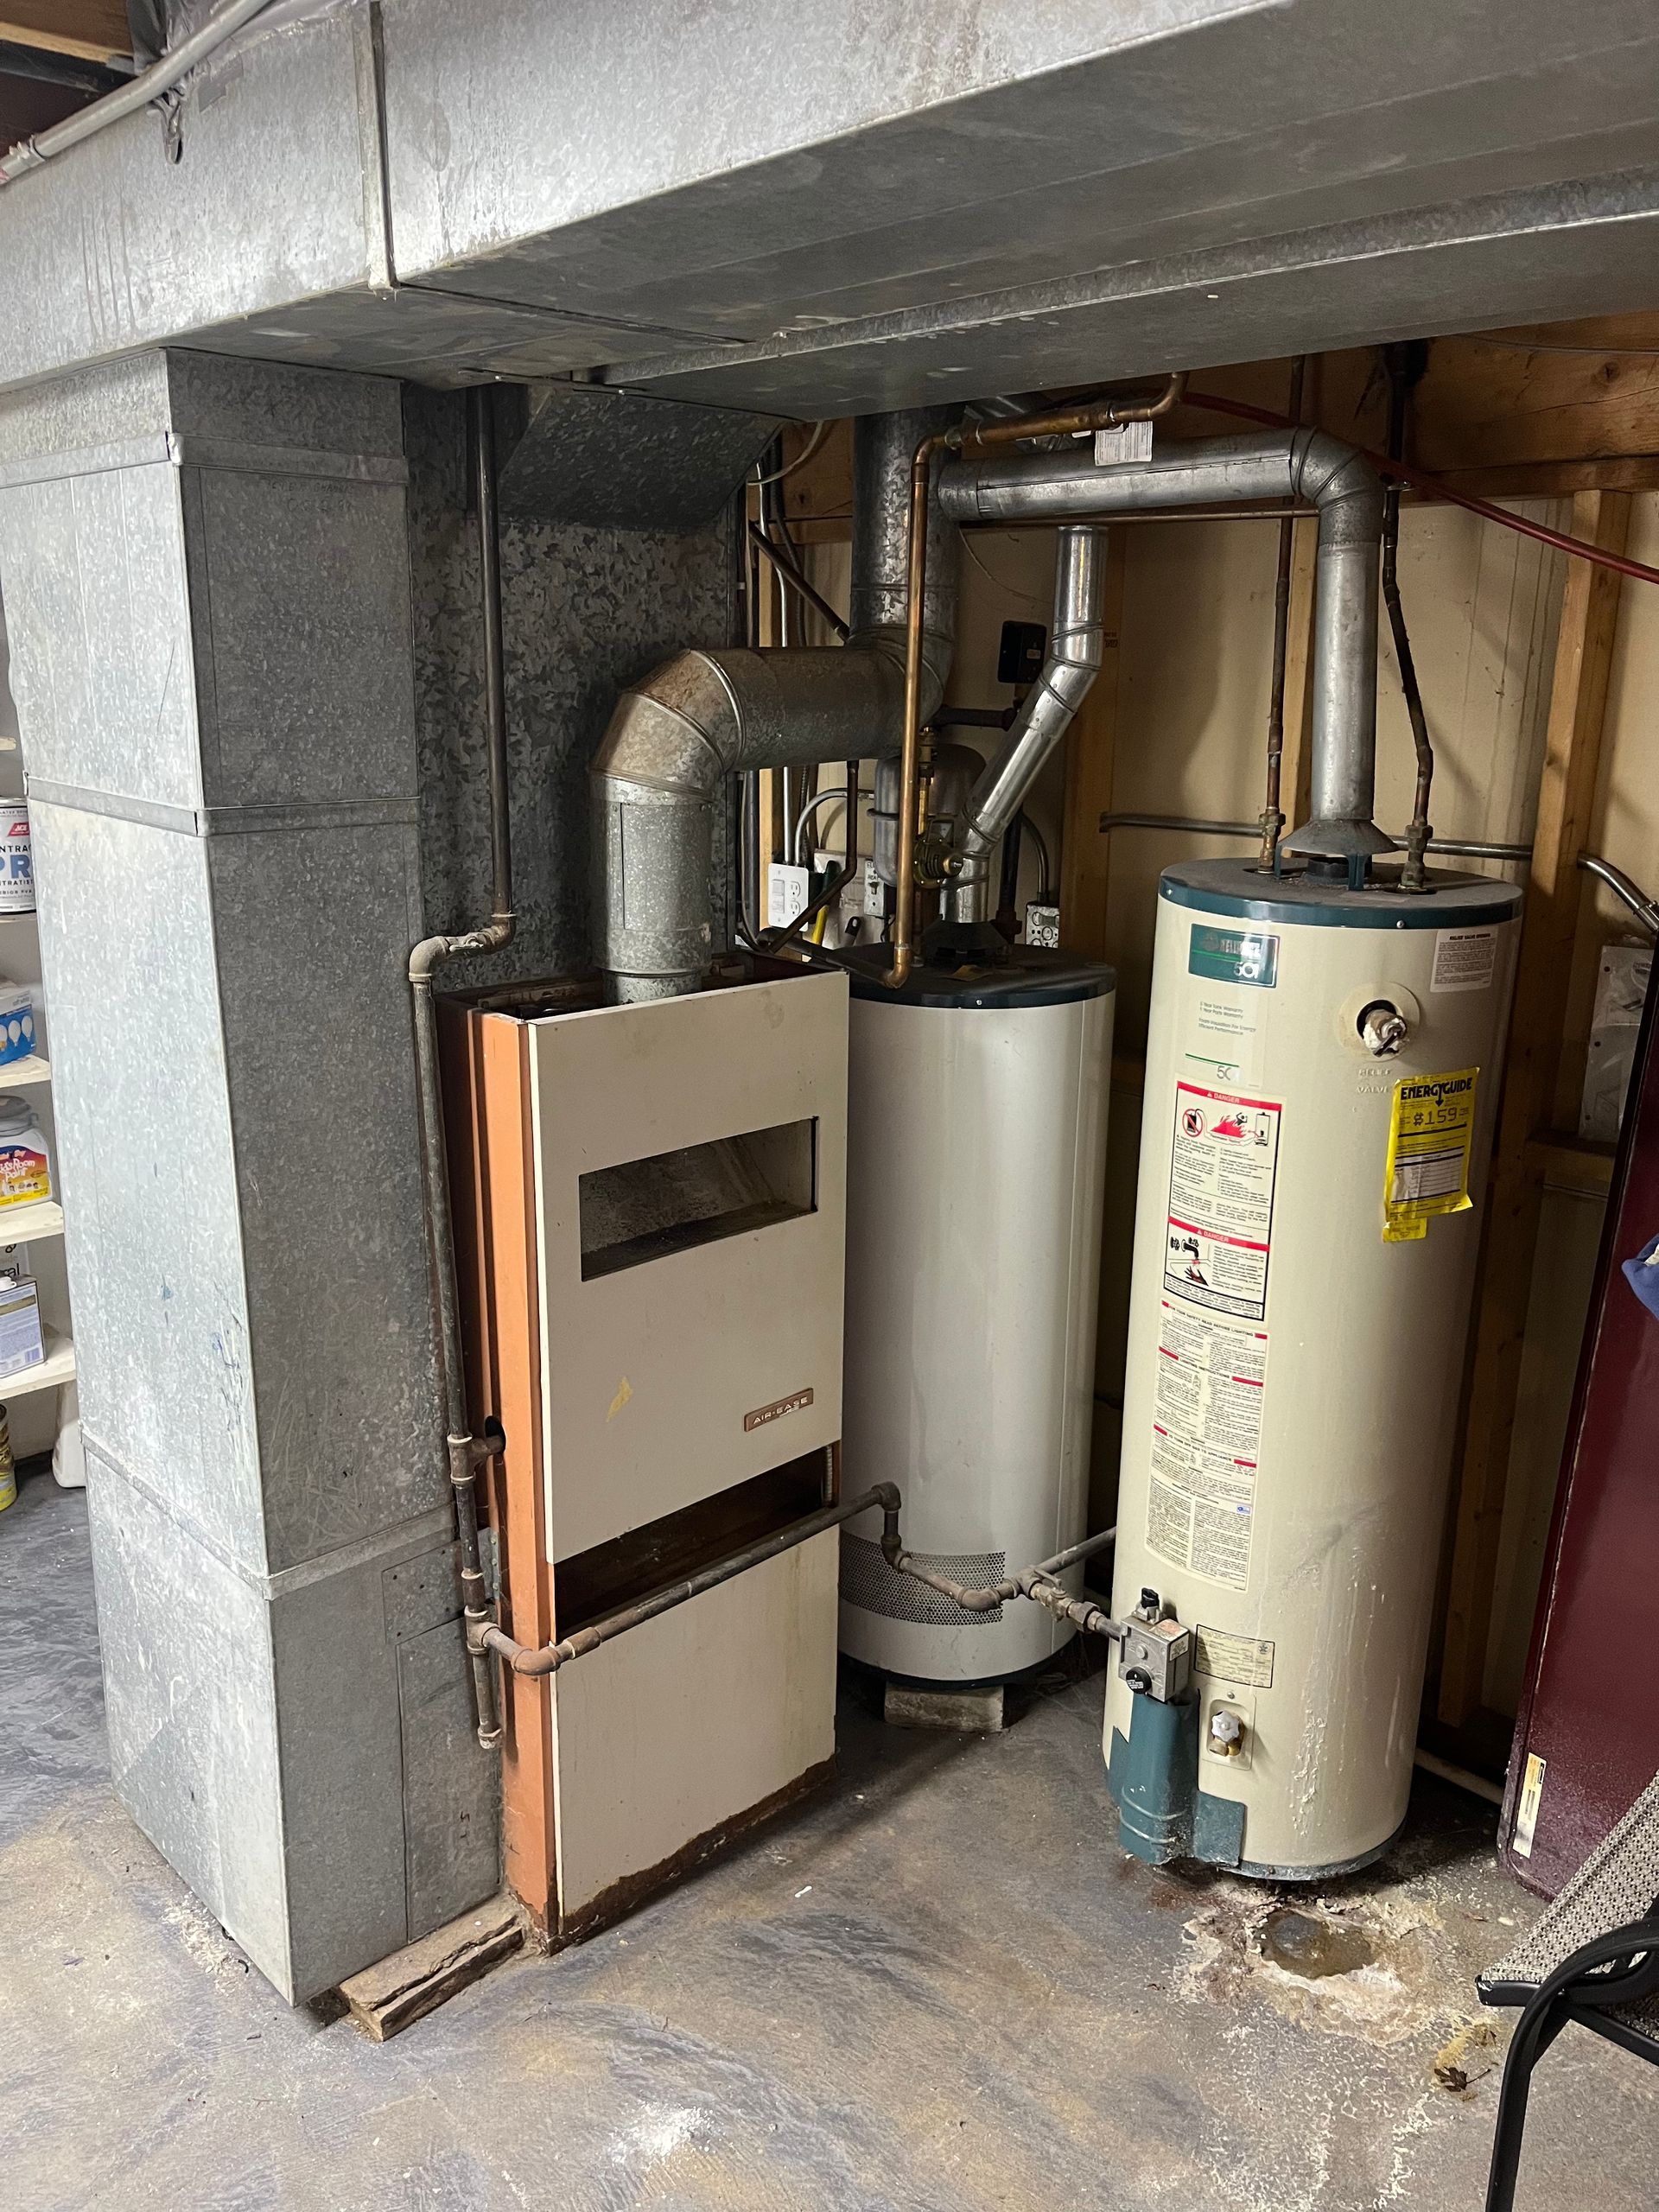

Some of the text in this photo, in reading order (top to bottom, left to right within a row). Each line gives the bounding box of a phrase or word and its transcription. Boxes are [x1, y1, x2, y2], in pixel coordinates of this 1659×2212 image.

[1401, 1077, 1472, 1101] ENERGYGUIDE
[1214, 1092, 1240, 1104] DANGER
[13, 1158, 35, 1170] Room
[1204, 1231, 1230, 1243] DANGER
[1231, 1327, 1253, 1337] LIGHTING
